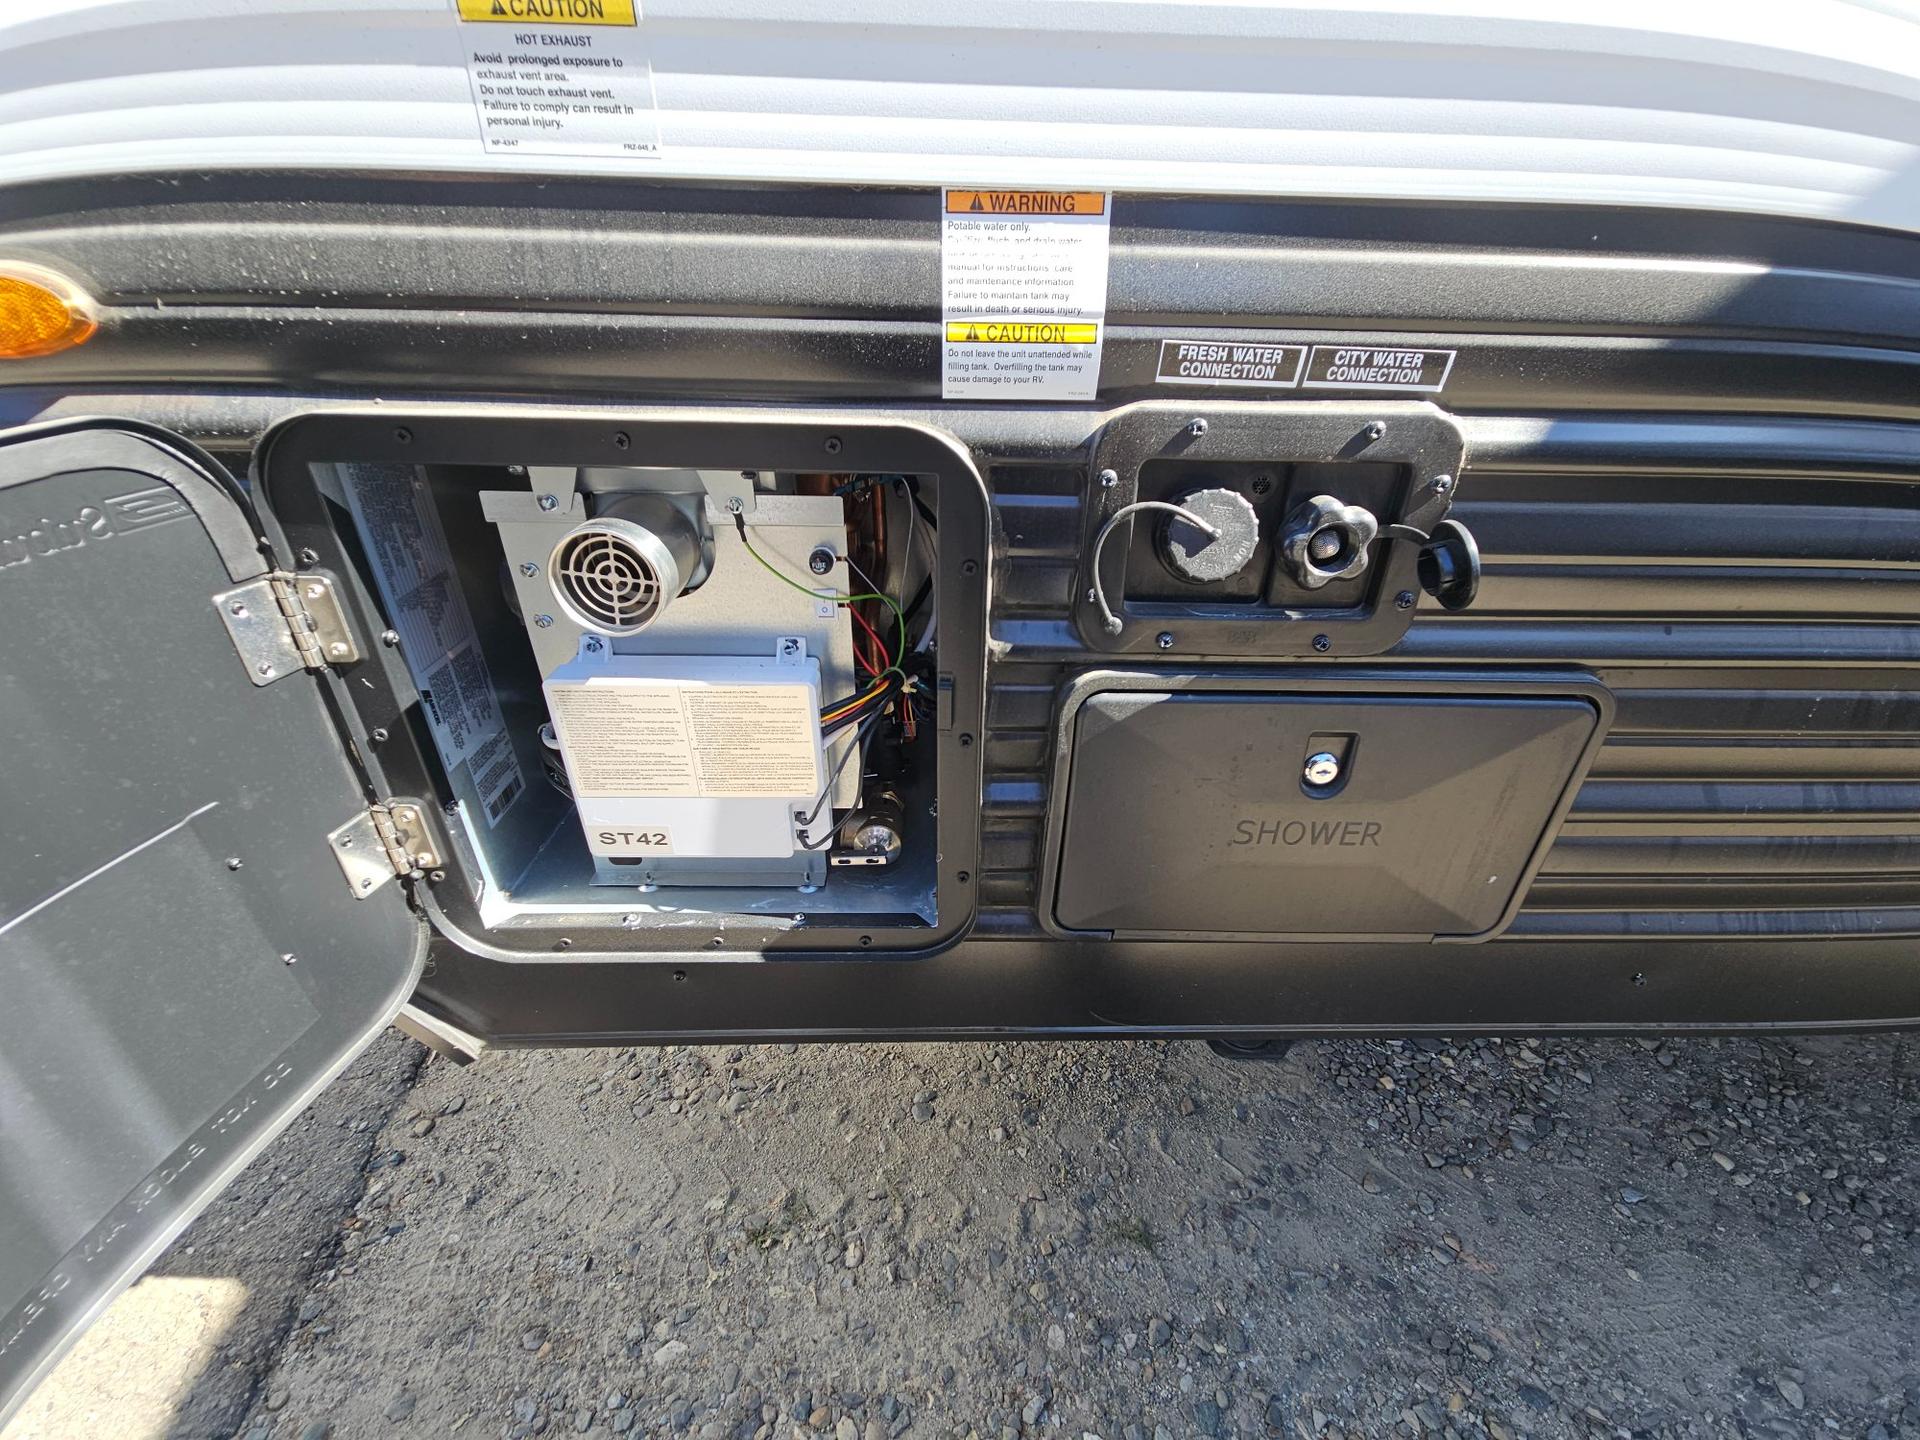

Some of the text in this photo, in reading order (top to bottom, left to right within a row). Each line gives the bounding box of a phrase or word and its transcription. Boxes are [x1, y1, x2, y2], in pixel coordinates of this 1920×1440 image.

[510, 0, 604, 18] CAUTION
[515, 34, 592, 47] HOT EXHAUST
[474, 52, 623, 69] Avoid prolonged exposure to
[477, 69, 569, 82] exhaust vent area.
[480, 84, 615, 99] Do not touch exhaust vent.
[483, 99, 634, 114] Failure to comply can result in
[486, 116, 564, 130] personal injury.
[989, 194, 1075, 212] WARNING
[947, 220, 1031, 233] Potable water only.
[947, 263, 980, 271] manual
[982, 263, 994, 271] for
[947, 277, 964, 285] and
[966, 277, 1022, 286] maintenance
[947, 290, 1070, 302] Failure to maintain tank may
[947, 305, 973, 313] result
[974, 305, 983, 313] in
[985, 305, 1009, 313] death
[1023, 305, 1054, 314] serious
[1057, 306, 1084, 316] injury.
[986, 325, 1066, 341] CAUTION
[947, 348, 1093, 359] Do not leave the unit unattended while
[1178, 345, 1284, 364] FRESH WATER
[1334, 350, 1425, 368] CITY WATER
[947, 362, 1083, 373] filling tank. Overfilling the tank may
[1179, 361, 1277, 380] CONNECTION
[1326, 366, 1423, 384] CONNECTION
[947, 374, 1045, 386] cause damage to your RV.
[598, 831, 669, 846] ST42
[1232, 819, 1383, 847] SHOWER
